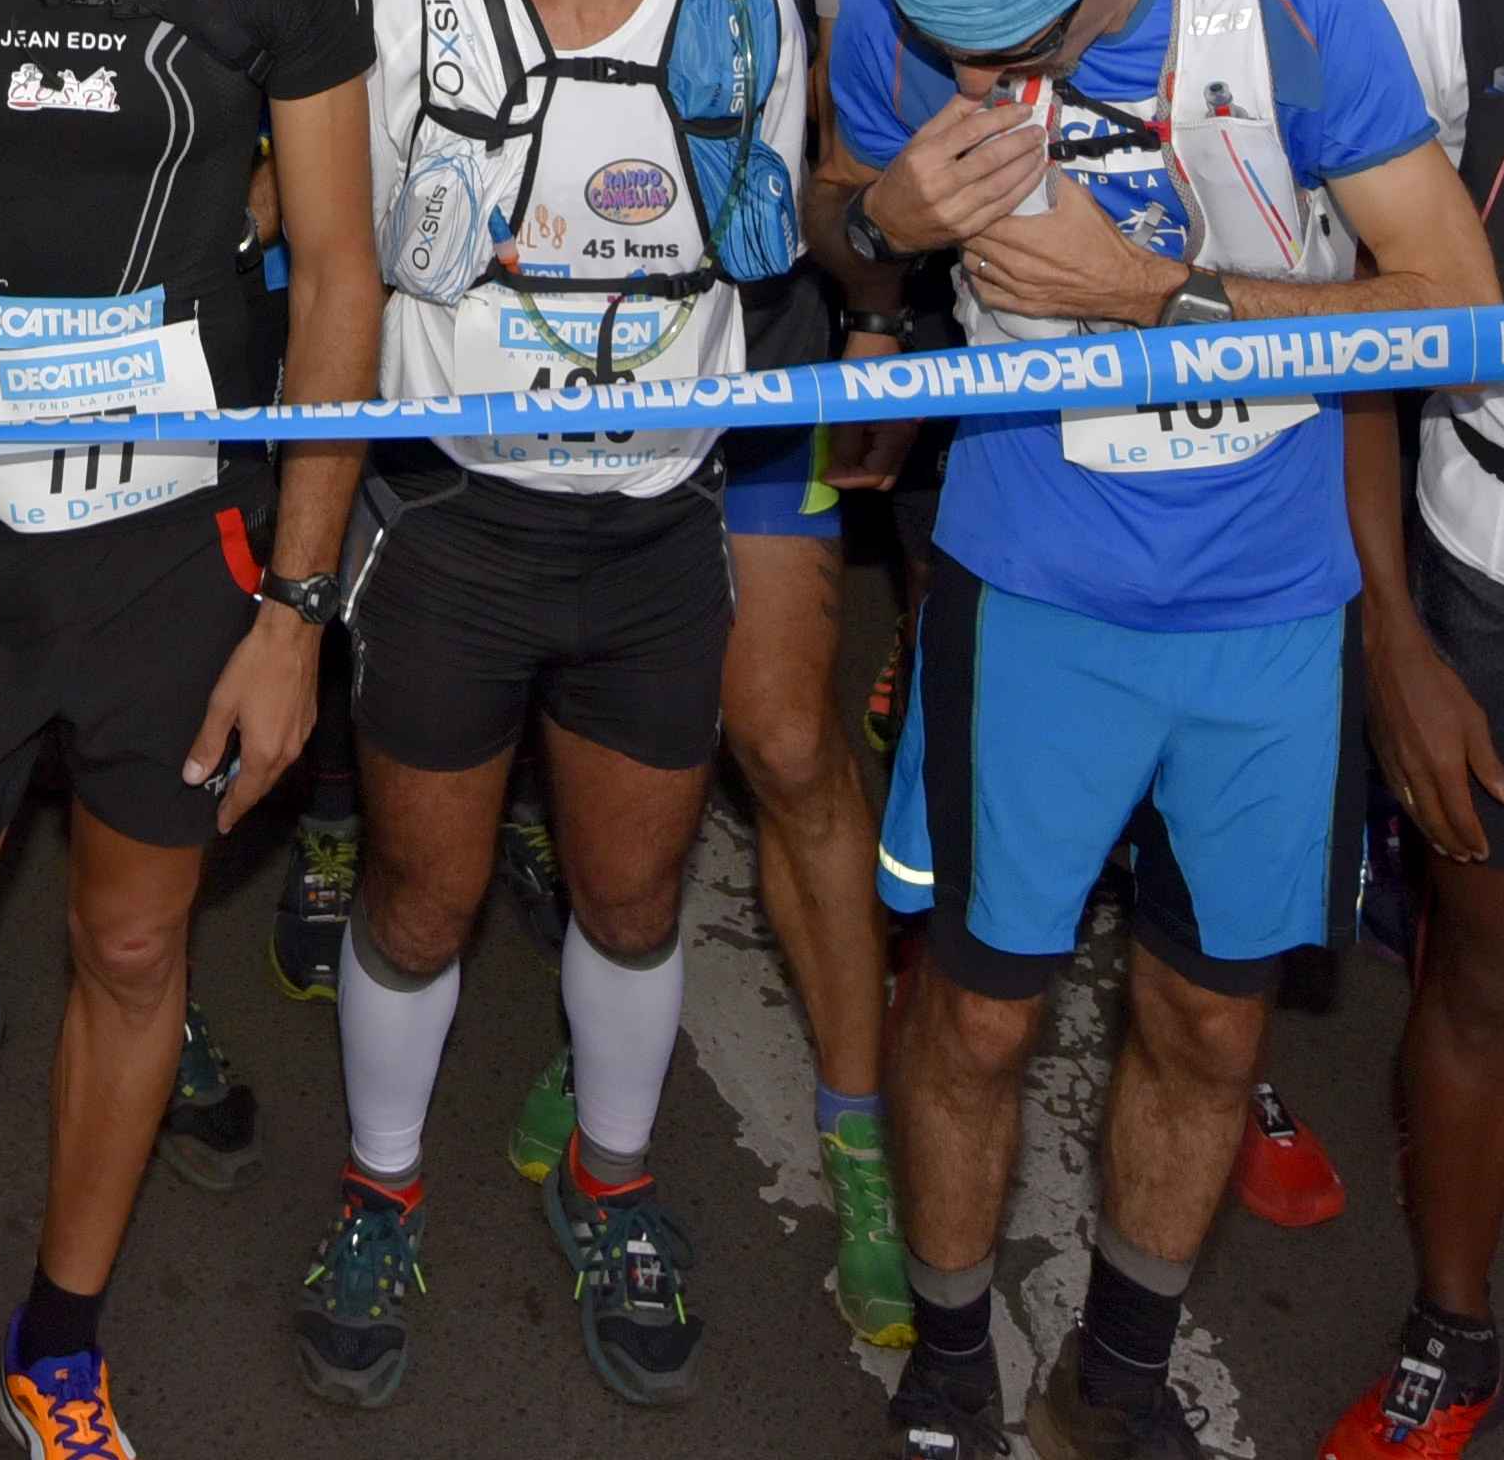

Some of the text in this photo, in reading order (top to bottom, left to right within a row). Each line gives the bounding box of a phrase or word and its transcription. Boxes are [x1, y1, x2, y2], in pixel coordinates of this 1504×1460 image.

[0, 29, 127, 52] JEAN EDDY
[603, 168, 663, 189] RANDO
[1077, 172, 1160, 189] ND LA
[412, 183, 448, 271] Oxsitis
[582, 238, 680, 259] 45 kms
[508, 317, 651, 344] DECATHON
[1170, 324, 1449, 385] DECATHLON
[7, 351, 155, 392] DECATHLON
[845, 344, 1123, 402] DECATHLON
[29, 399, 70, 411] FOND
[80, 397, 97, 407] LA
[107, 388, 160, 403] FORME
[548, 446, 656, 468] D-Tour
[1107, 443, 1148, 465] Le
[9, 480, 179, 525] Le D-Tour
